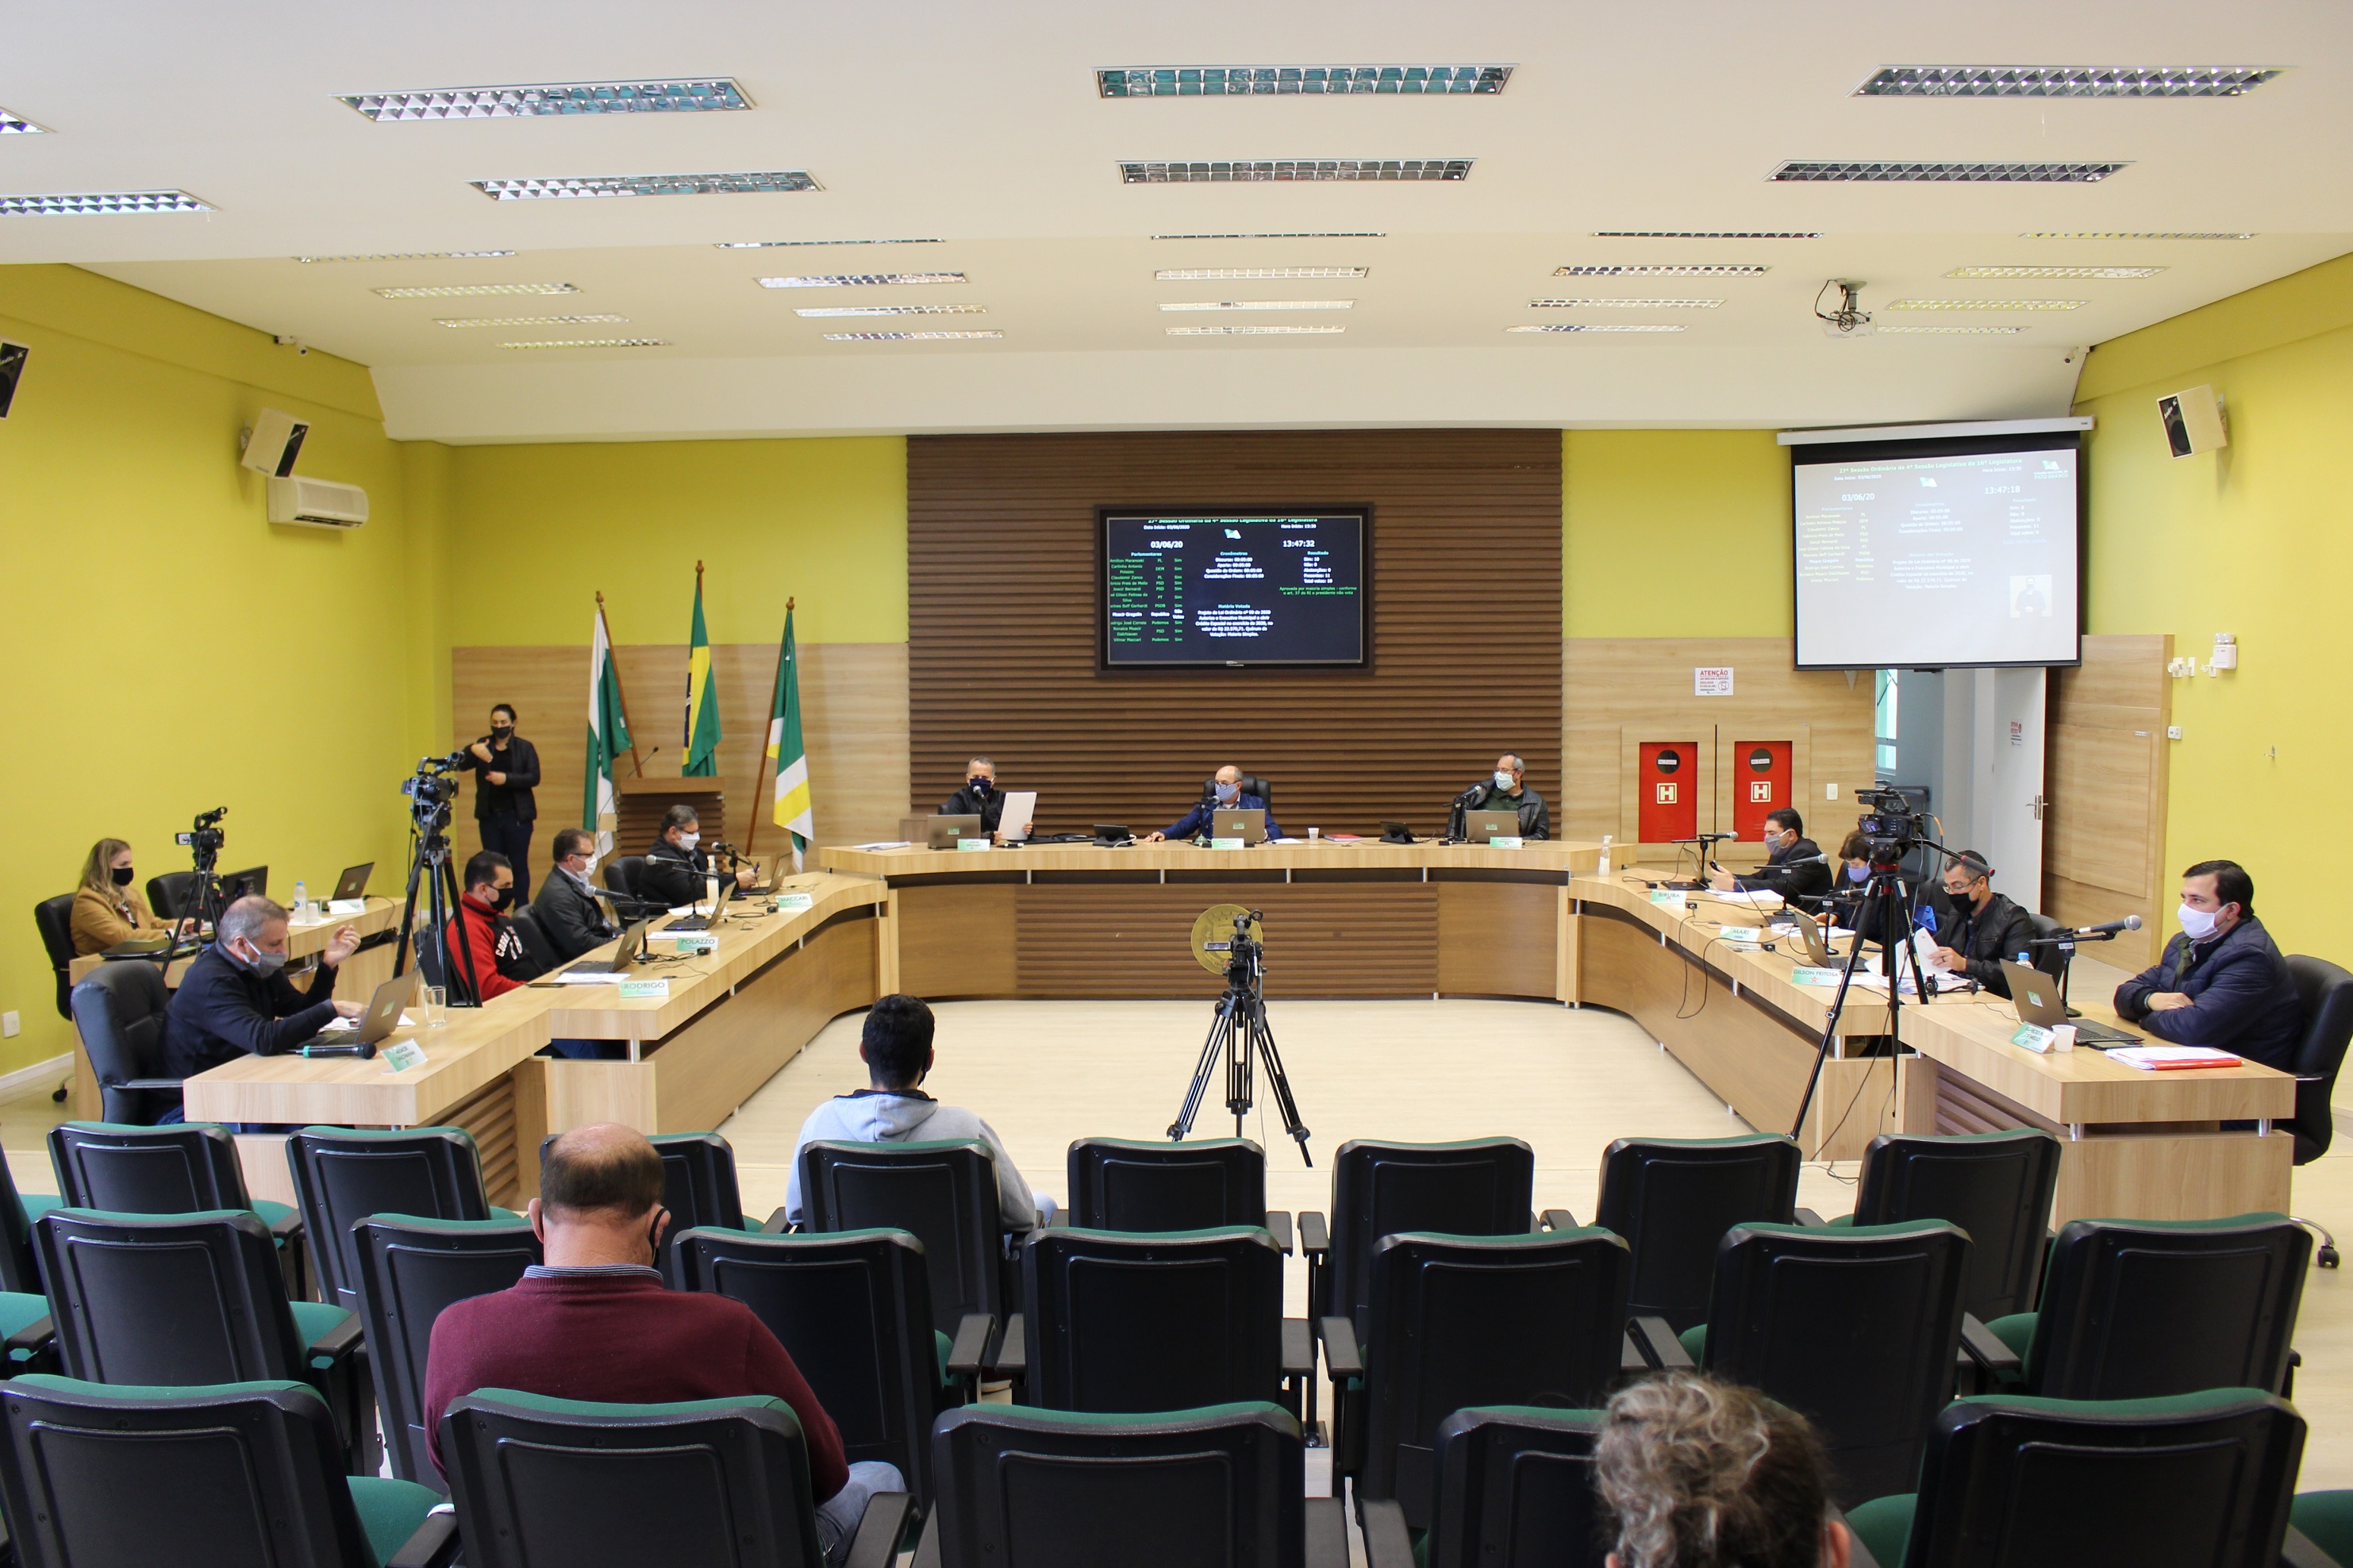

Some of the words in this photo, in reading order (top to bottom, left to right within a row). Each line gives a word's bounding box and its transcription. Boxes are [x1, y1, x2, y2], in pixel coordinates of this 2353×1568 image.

[1935, 461, 1967, 470] Legislativa
[1985, 485, 2020, 495] 13:47:18
[1842, 493, 1875, 502] 03/06/20
[1150, 540, 1183, 549] 03/06/20
[1660, 786, 1674, 801] H
[1753, 784, 1768, 799] H
[624, 982, 665, 990] RODRIGO
